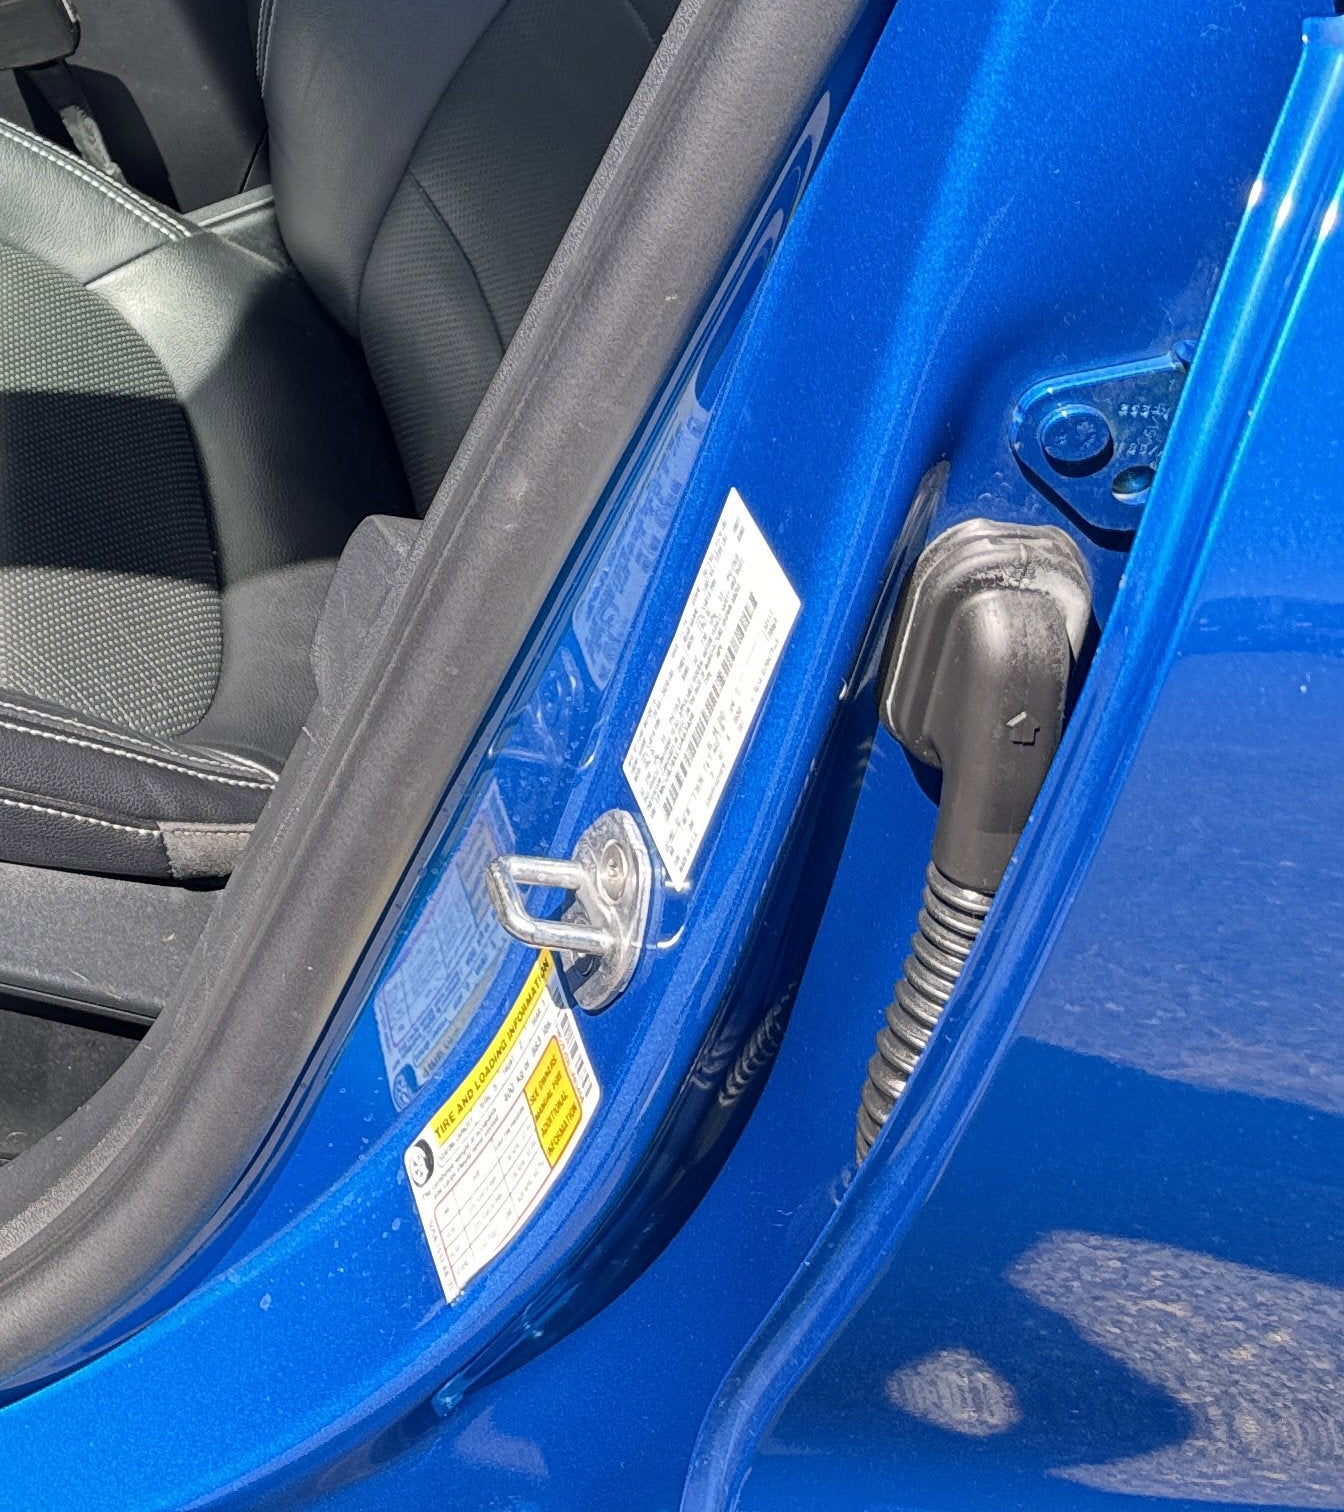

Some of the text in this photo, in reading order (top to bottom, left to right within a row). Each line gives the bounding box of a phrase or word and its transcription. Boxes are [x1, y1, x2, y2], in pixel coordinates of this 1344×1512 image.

[434, 1112, 456, 1138] TIRE
[457, 1090, 474, 1113] AND
[474, 1039, 507, 1089] LOADING
[507, 957, 550, 1039] INFORMATION
